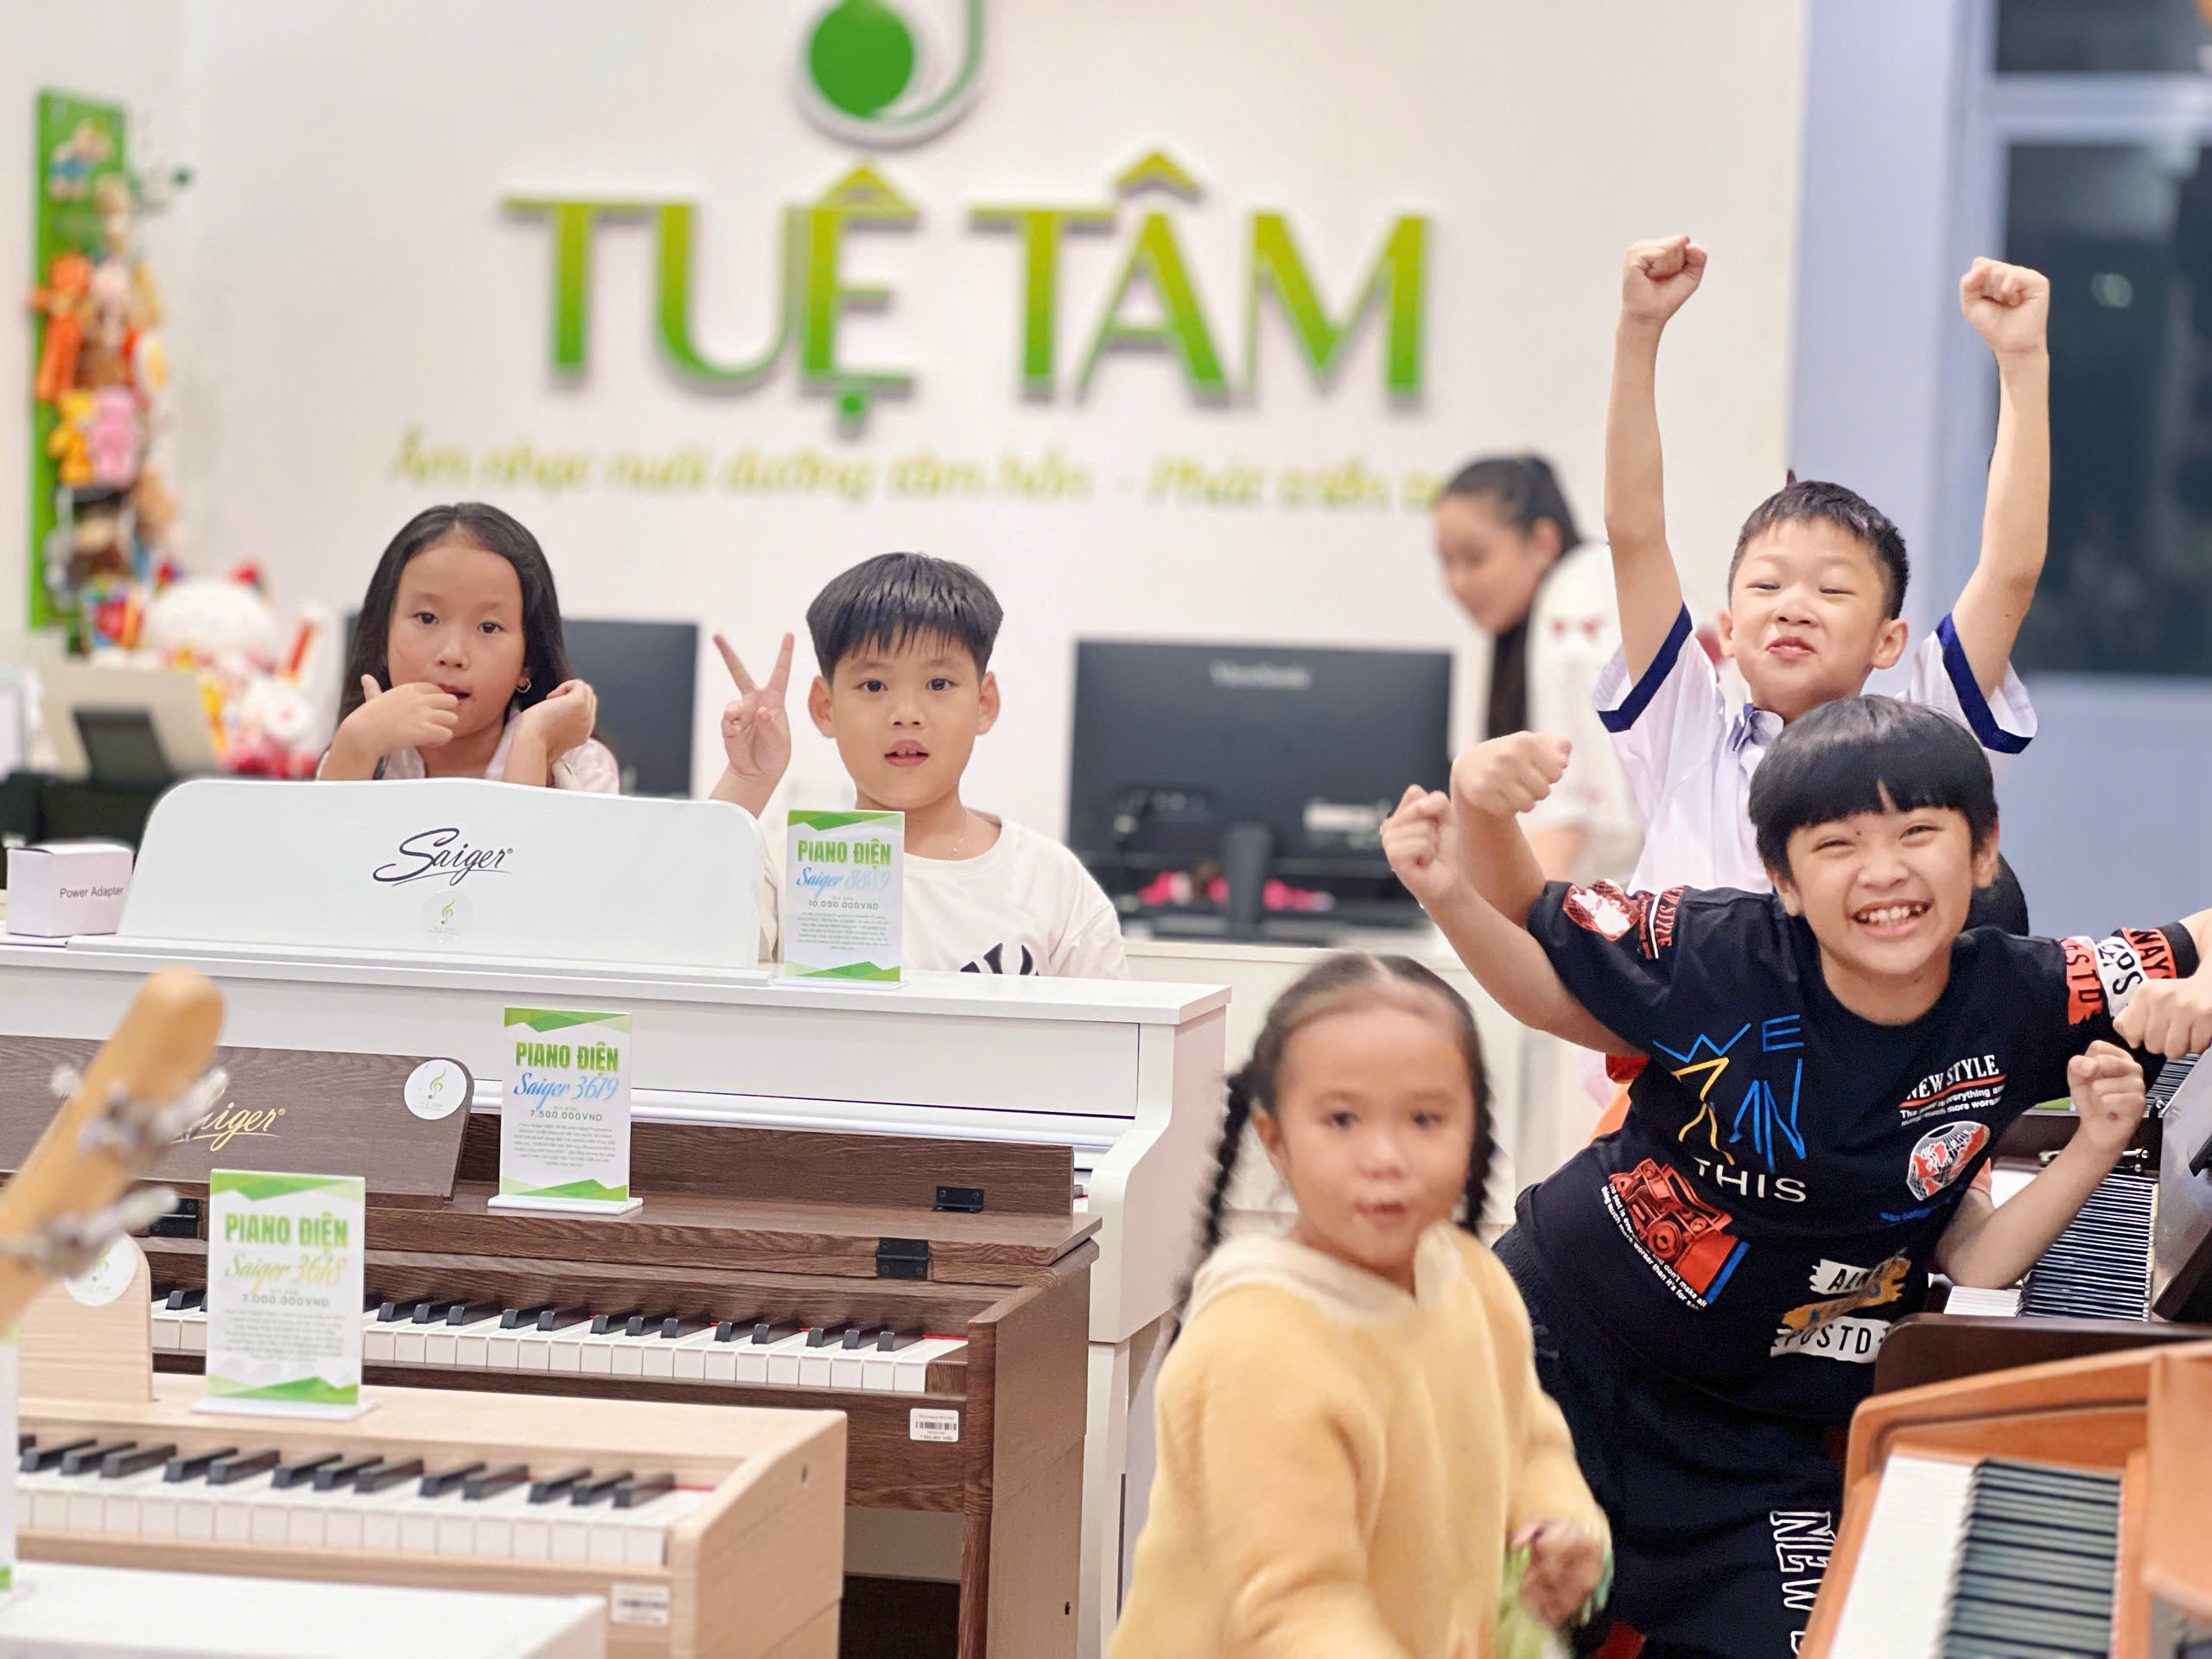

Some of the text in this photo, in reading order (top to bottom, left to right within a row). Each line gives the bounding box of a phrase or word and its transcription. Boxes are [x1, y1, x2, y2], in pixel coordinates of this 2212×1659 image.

[504, 150, 1431, 423] TUỆ TÂM
[373, 828, 506, 887] Saiger
[798, 838, 891, 870] PIANO ĐIỆN
[60, 887, 124, 898] Power Adapter
[796, 867, 844, 899] Saiger
[2130, 931, 2171, 979] WAY
[516, 1040, 619, 1075] PIANO ĐIỆN
[1906, 1054, 1999, 1100] NEW STYLE
[513, 1072, 619, 1110] Saiger 3619
[1947, 1103, 1970, 1113] more
[530, 1109, 602, 1122] 7.500.000VND
[1694, 1156, 1806, 1203] THIS
[225, 1211, 349, 1252] PIANO ĐIỆN
[224, 1251, 290, 1294] Saiger
[1652, 1263, 1667, 1281] than
[1675, 1289, 1688, 1300] for
[1663, 1264, 1681, 1282] don't
[1679, 1281, 1697, 1300] make
[1696, 1298, 1707, 1307] all
